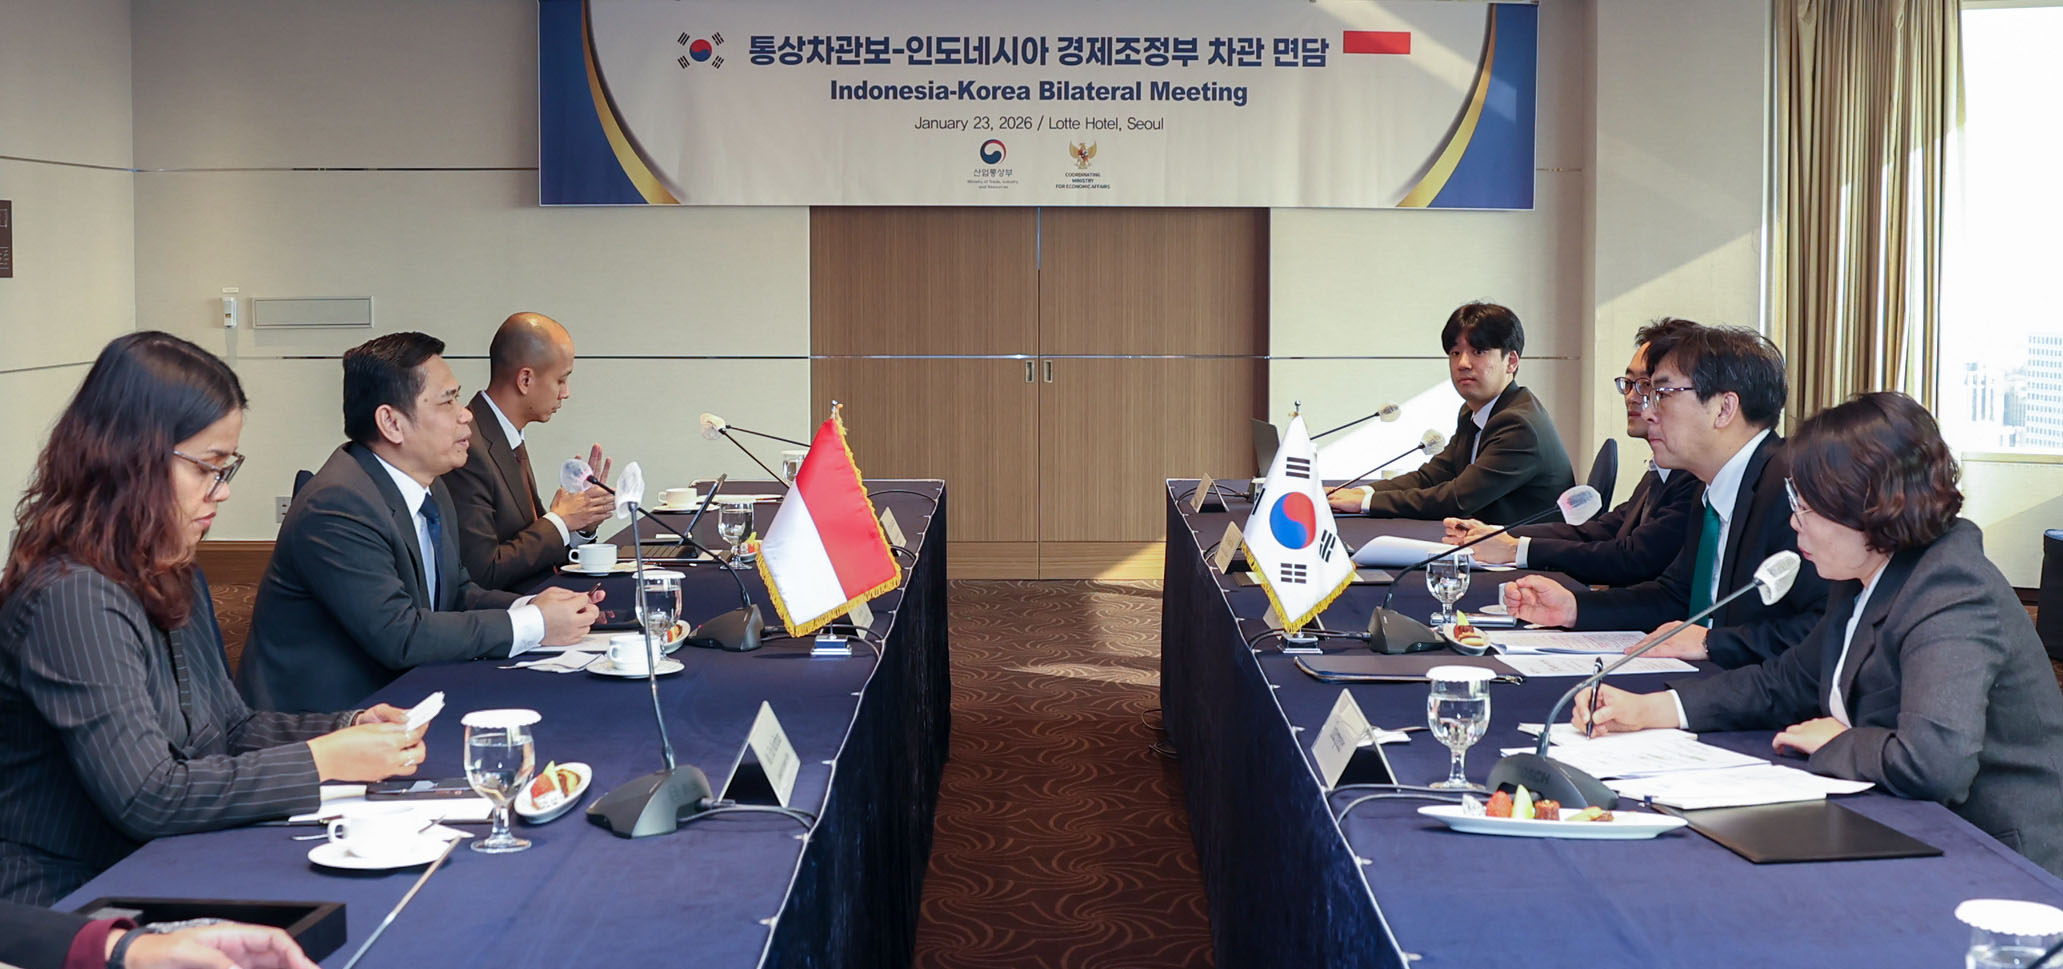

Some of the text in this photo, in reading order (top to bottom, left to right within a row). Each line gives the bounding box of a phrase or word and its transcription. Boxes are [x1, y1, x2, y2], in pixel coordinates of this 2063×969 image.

[748, 34, 1330, 69] 통상차관보-인도네시아 경제조정부 차관 면담
[830, 80, 1249, 106] Indonesia-Korea Bilateral Meeting
[914, 115, 1165, 132] January 23, 2026 / Lotte Hotel, Seoul
[973, 168, 1013, 177] 산업통상부
